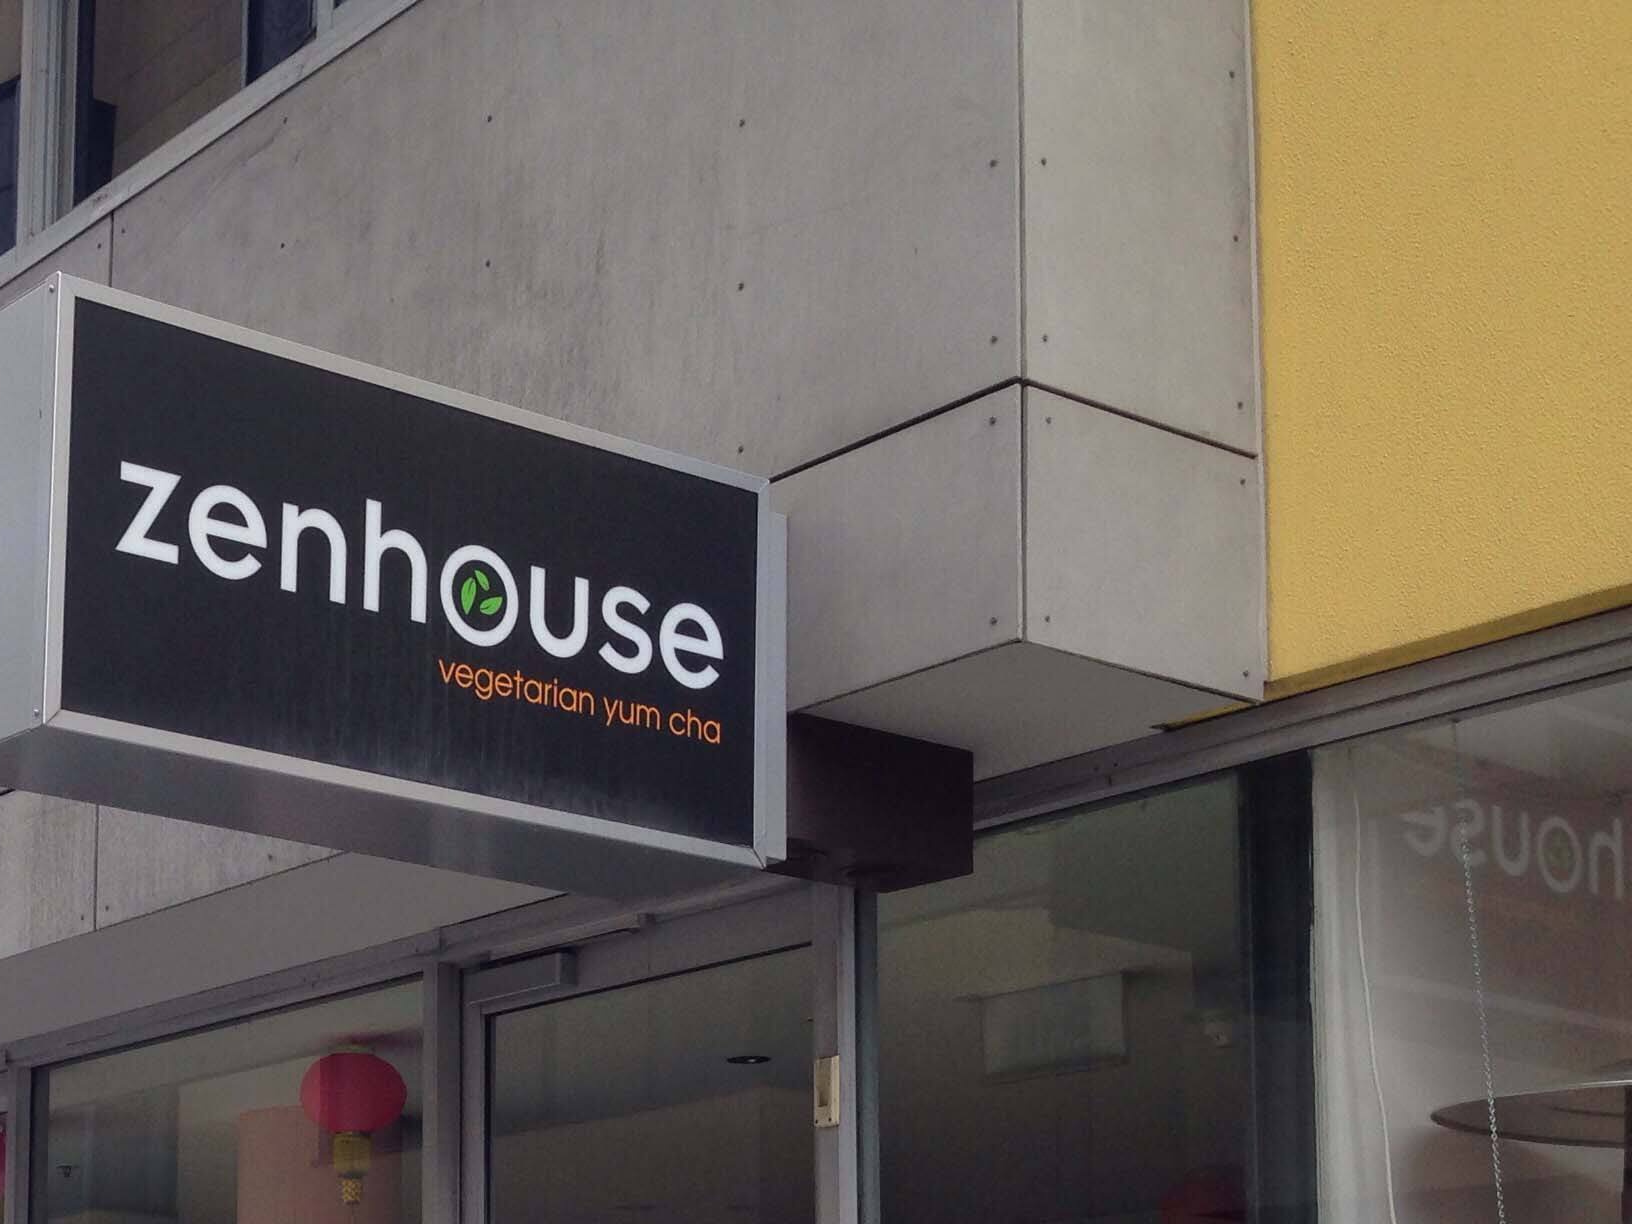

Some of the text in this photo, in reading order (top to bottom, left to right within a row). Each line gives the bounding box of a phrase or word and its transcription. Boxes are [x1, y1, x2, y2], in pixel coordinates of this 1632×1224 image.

[115, 460, 723, 689] zenhouse
[438, 659, 721, 744] vegetarian yum cha
